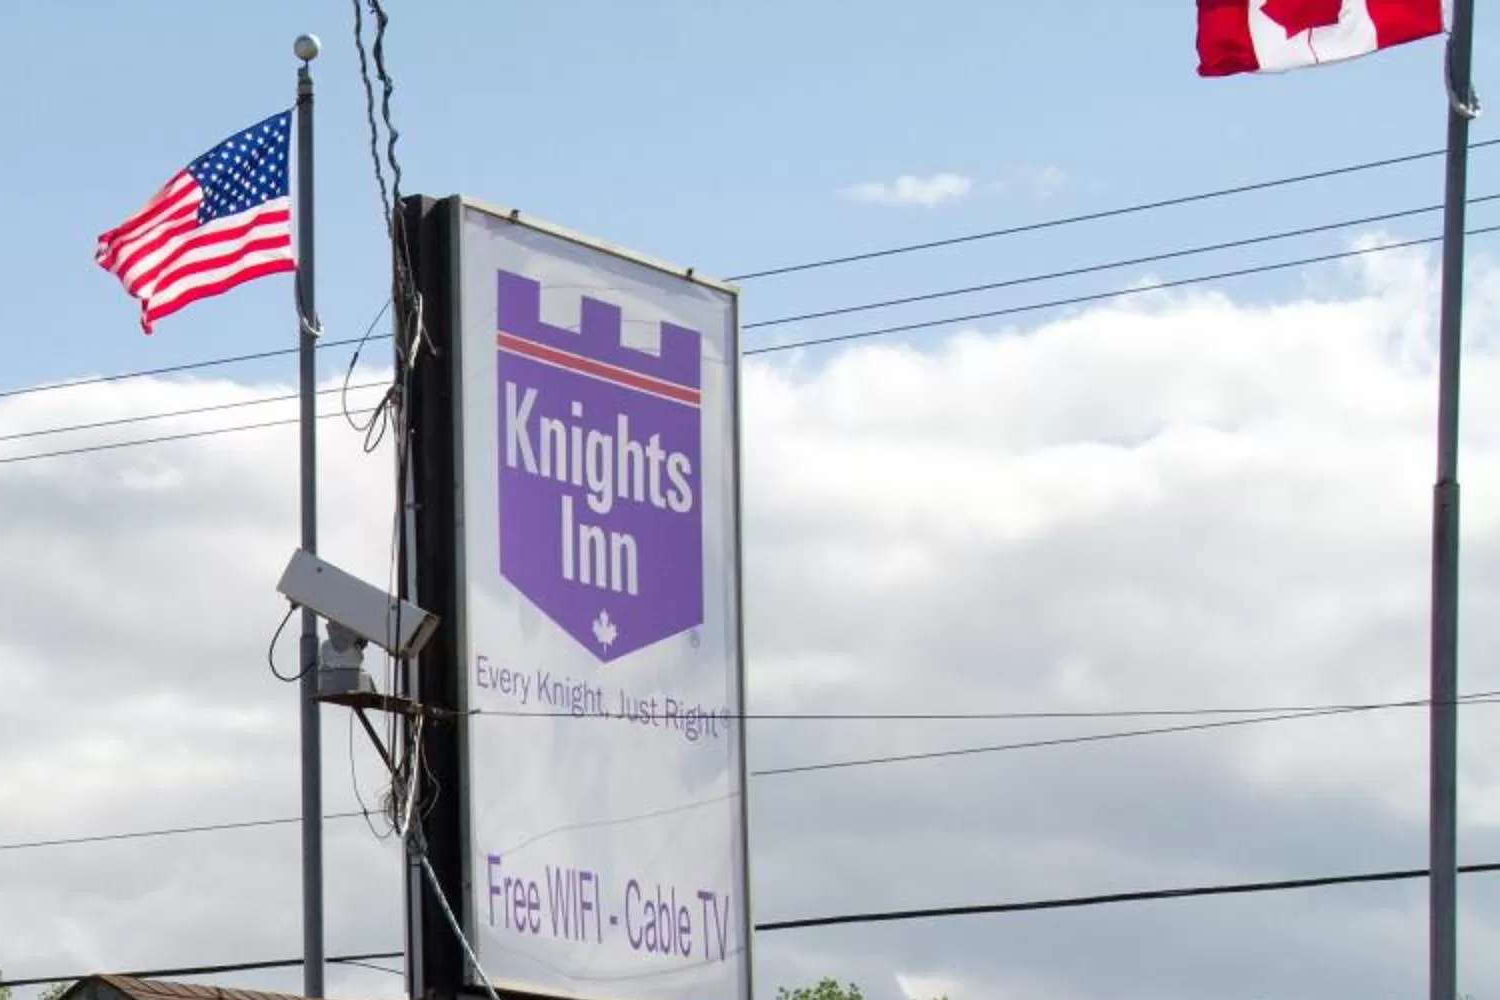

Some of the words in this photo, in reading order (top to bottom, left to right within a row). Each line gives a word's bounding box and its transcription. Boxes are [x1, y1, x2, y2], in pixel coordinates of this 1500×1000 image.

[505, 381, 693, 514] Knights
[561, 495, 639, 595] Inn
[476, 656, 531, 704] Every
[615, 689, 658, 727] Just
[487, 854, 541, 935] Free
[546, 865, 602, 944] WIFI
[625, 879, 692, 957] Cable
[696, 890, 730, 961] TV
